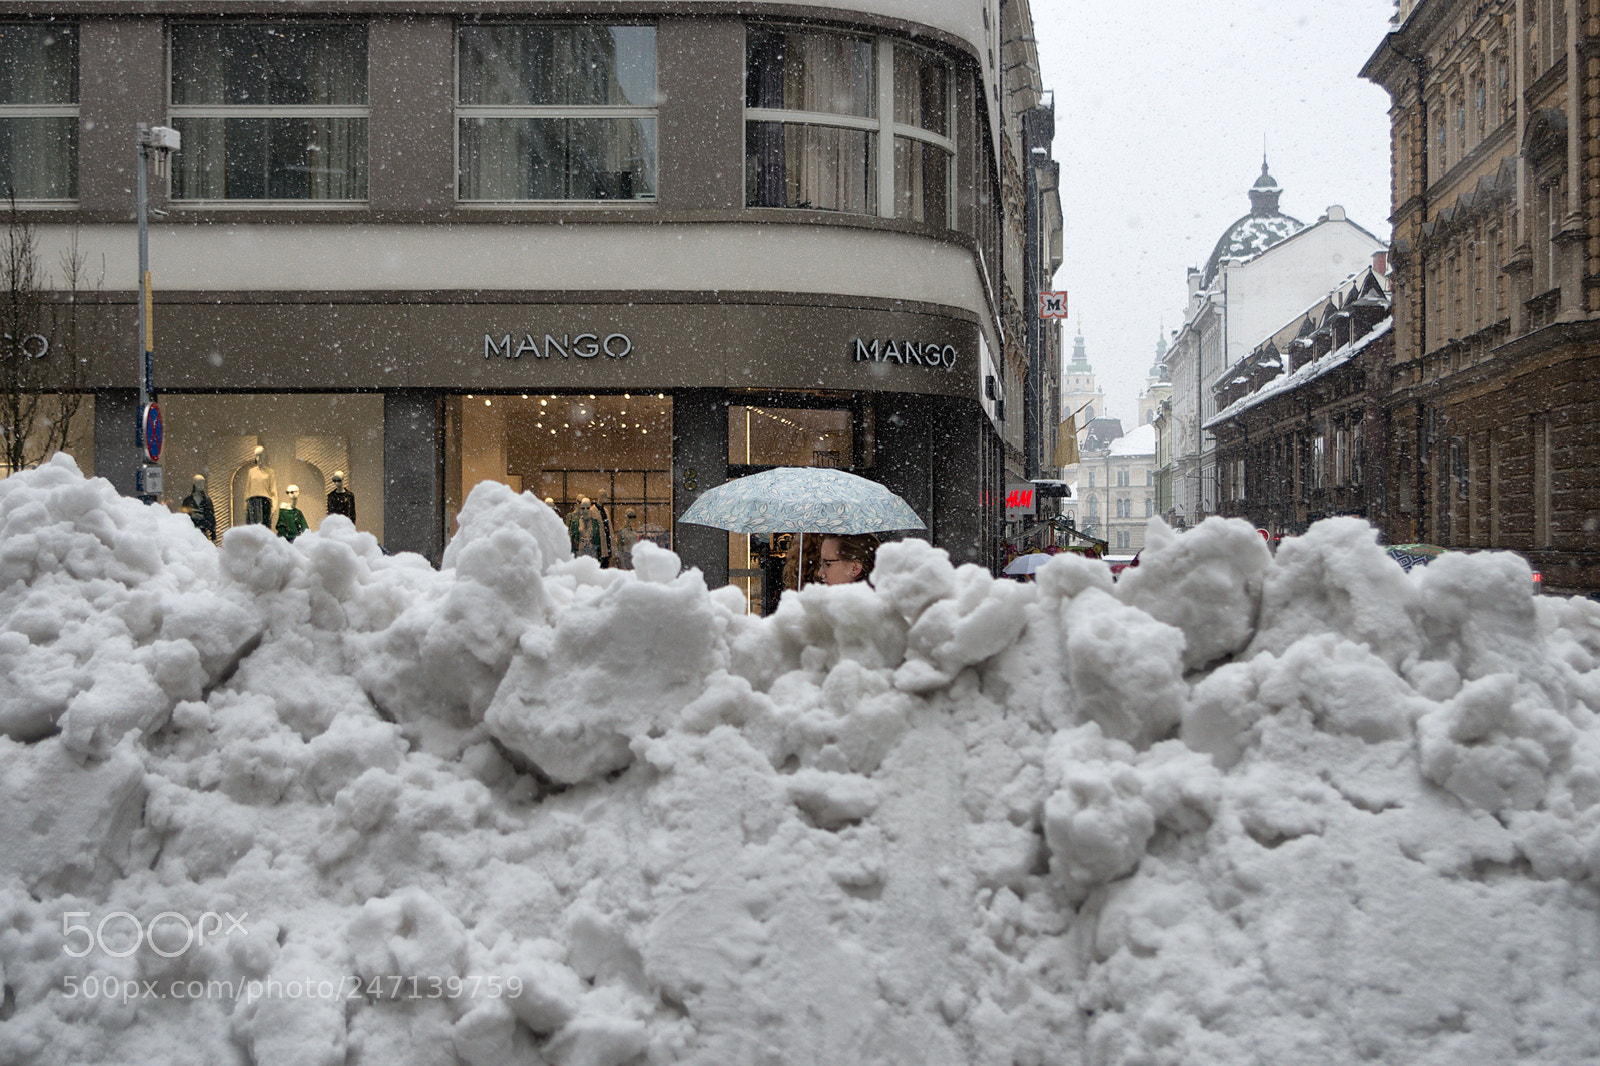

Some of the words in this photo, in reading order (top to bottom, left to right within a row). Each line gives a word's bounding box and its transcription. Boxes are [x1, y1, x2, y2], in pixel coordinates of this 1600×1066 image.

[1046, 299, 1061, 311] M
[484, 332, 632, 358] MANGO
[855, 338, 957, 368] MANGO
